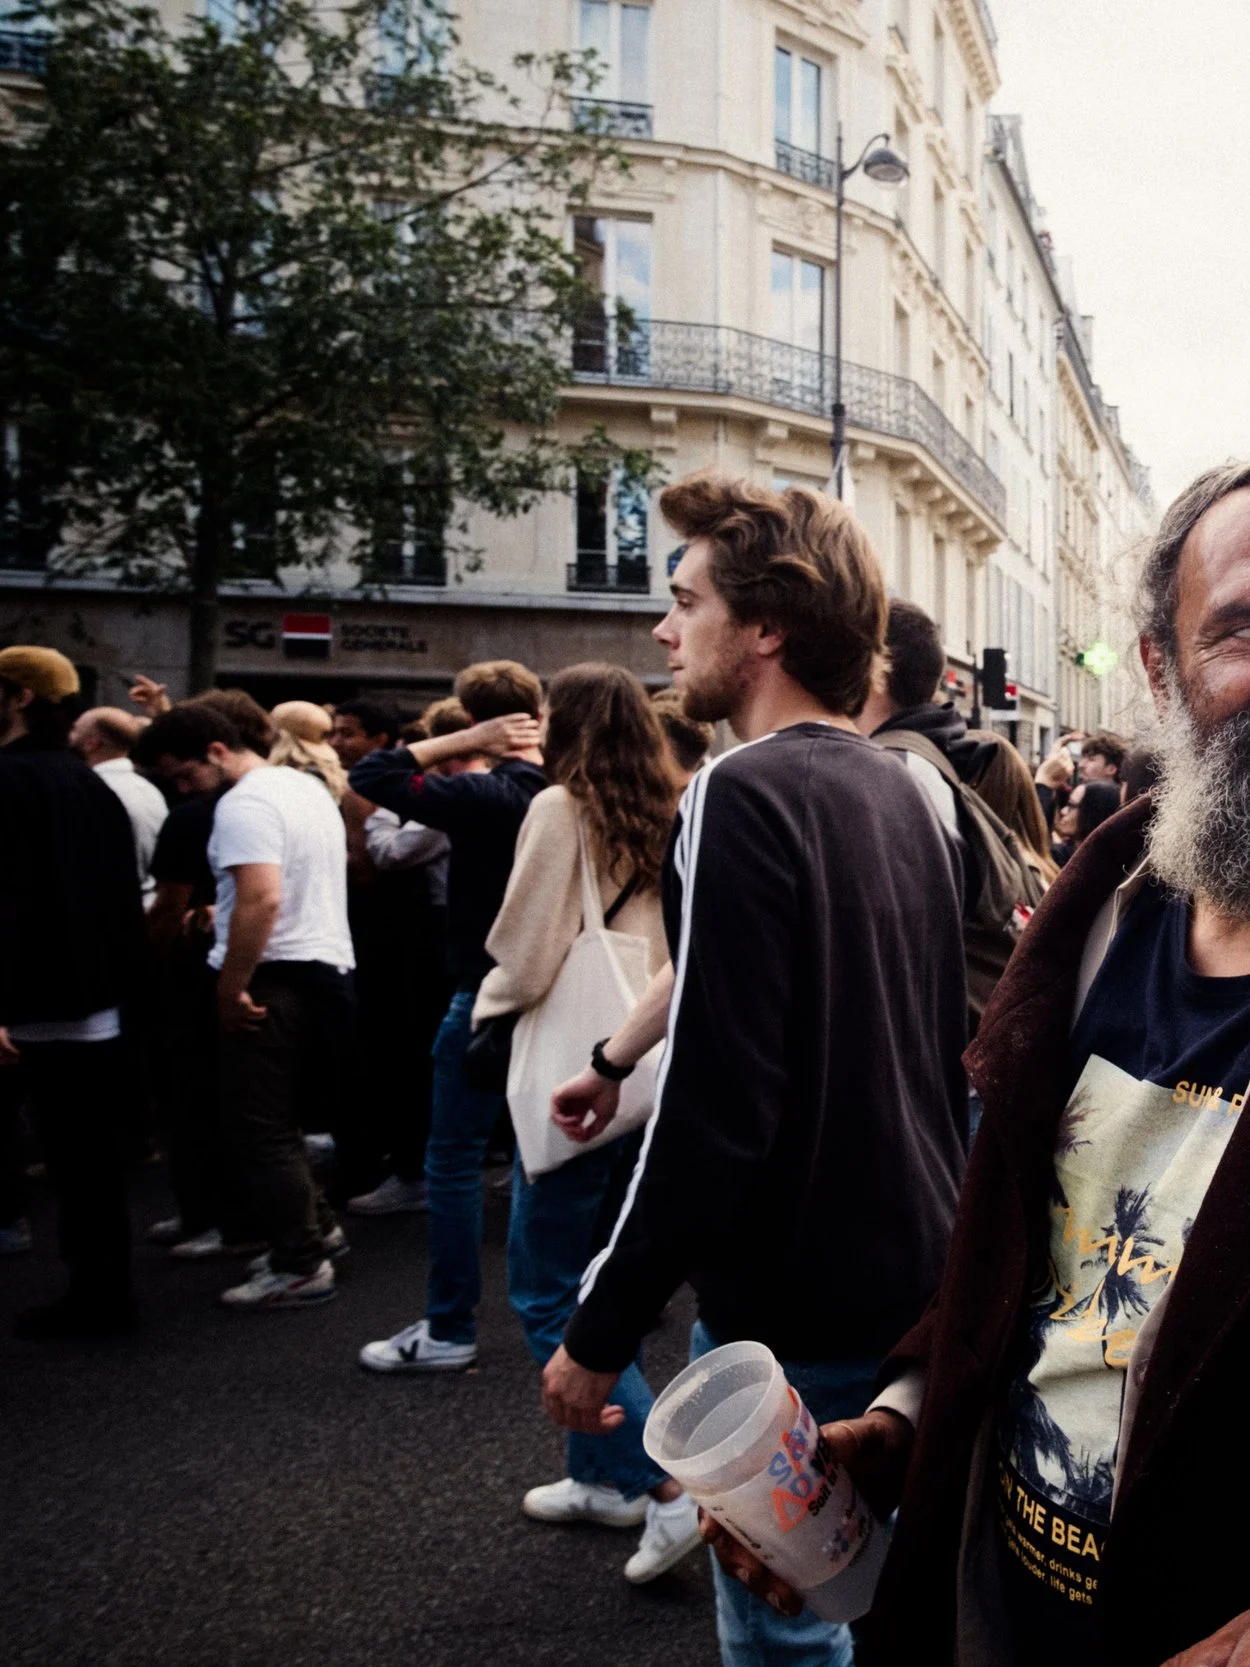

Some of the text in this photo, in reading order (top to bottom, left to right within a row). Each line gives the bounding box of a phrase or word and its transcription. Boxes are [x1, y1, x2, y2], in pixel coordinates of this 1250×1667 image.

[224, 620, 275, 648] SG
[1016, 1485, 1047, 1535] THE
[1051, 1516, 1105, 1561] BEA
[1049, 1558, 1082, 1583] drinks
[1085, 1576, 1098, 1590] ge
[1050, 1575, 1066, 1593] life
[1068, 1587, 1093, 1605] gets
